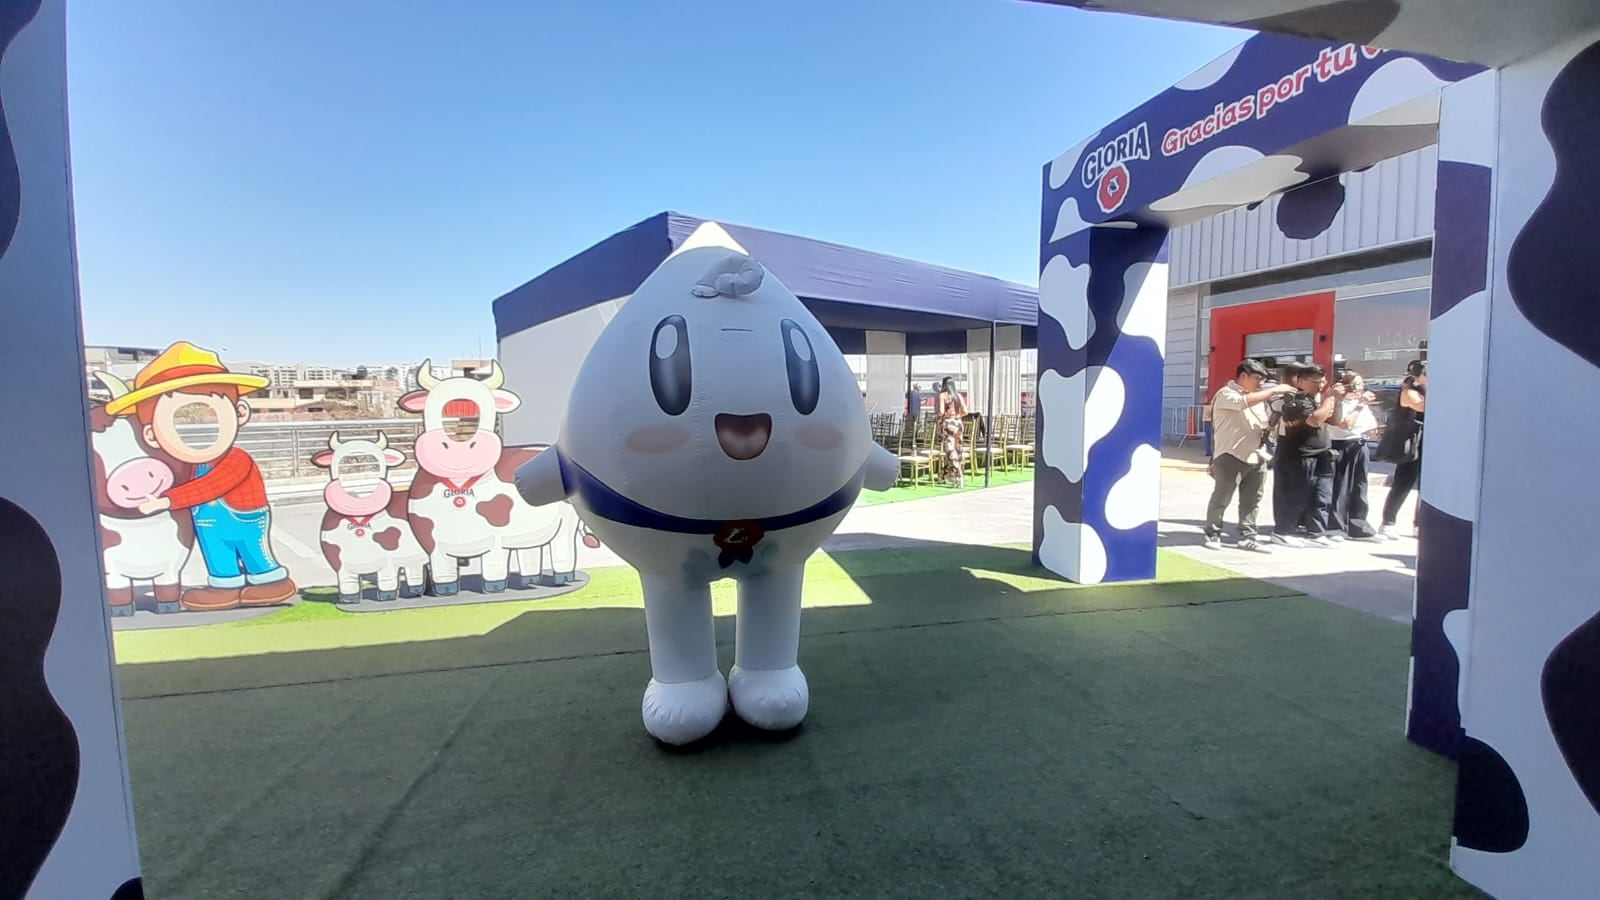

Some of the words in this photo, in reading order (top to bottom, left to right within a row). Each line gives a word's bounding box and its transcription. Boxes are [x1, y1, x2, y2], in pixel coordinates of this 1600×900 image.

[1162, 95, 1255, 156] Gracias
[1257, 64, 1311, 119] por
[1313, 43, 1357, 82] tu
[1082, 122, 1151, 189] GLORIA
[443, 488, 475, 498] GLORIA
